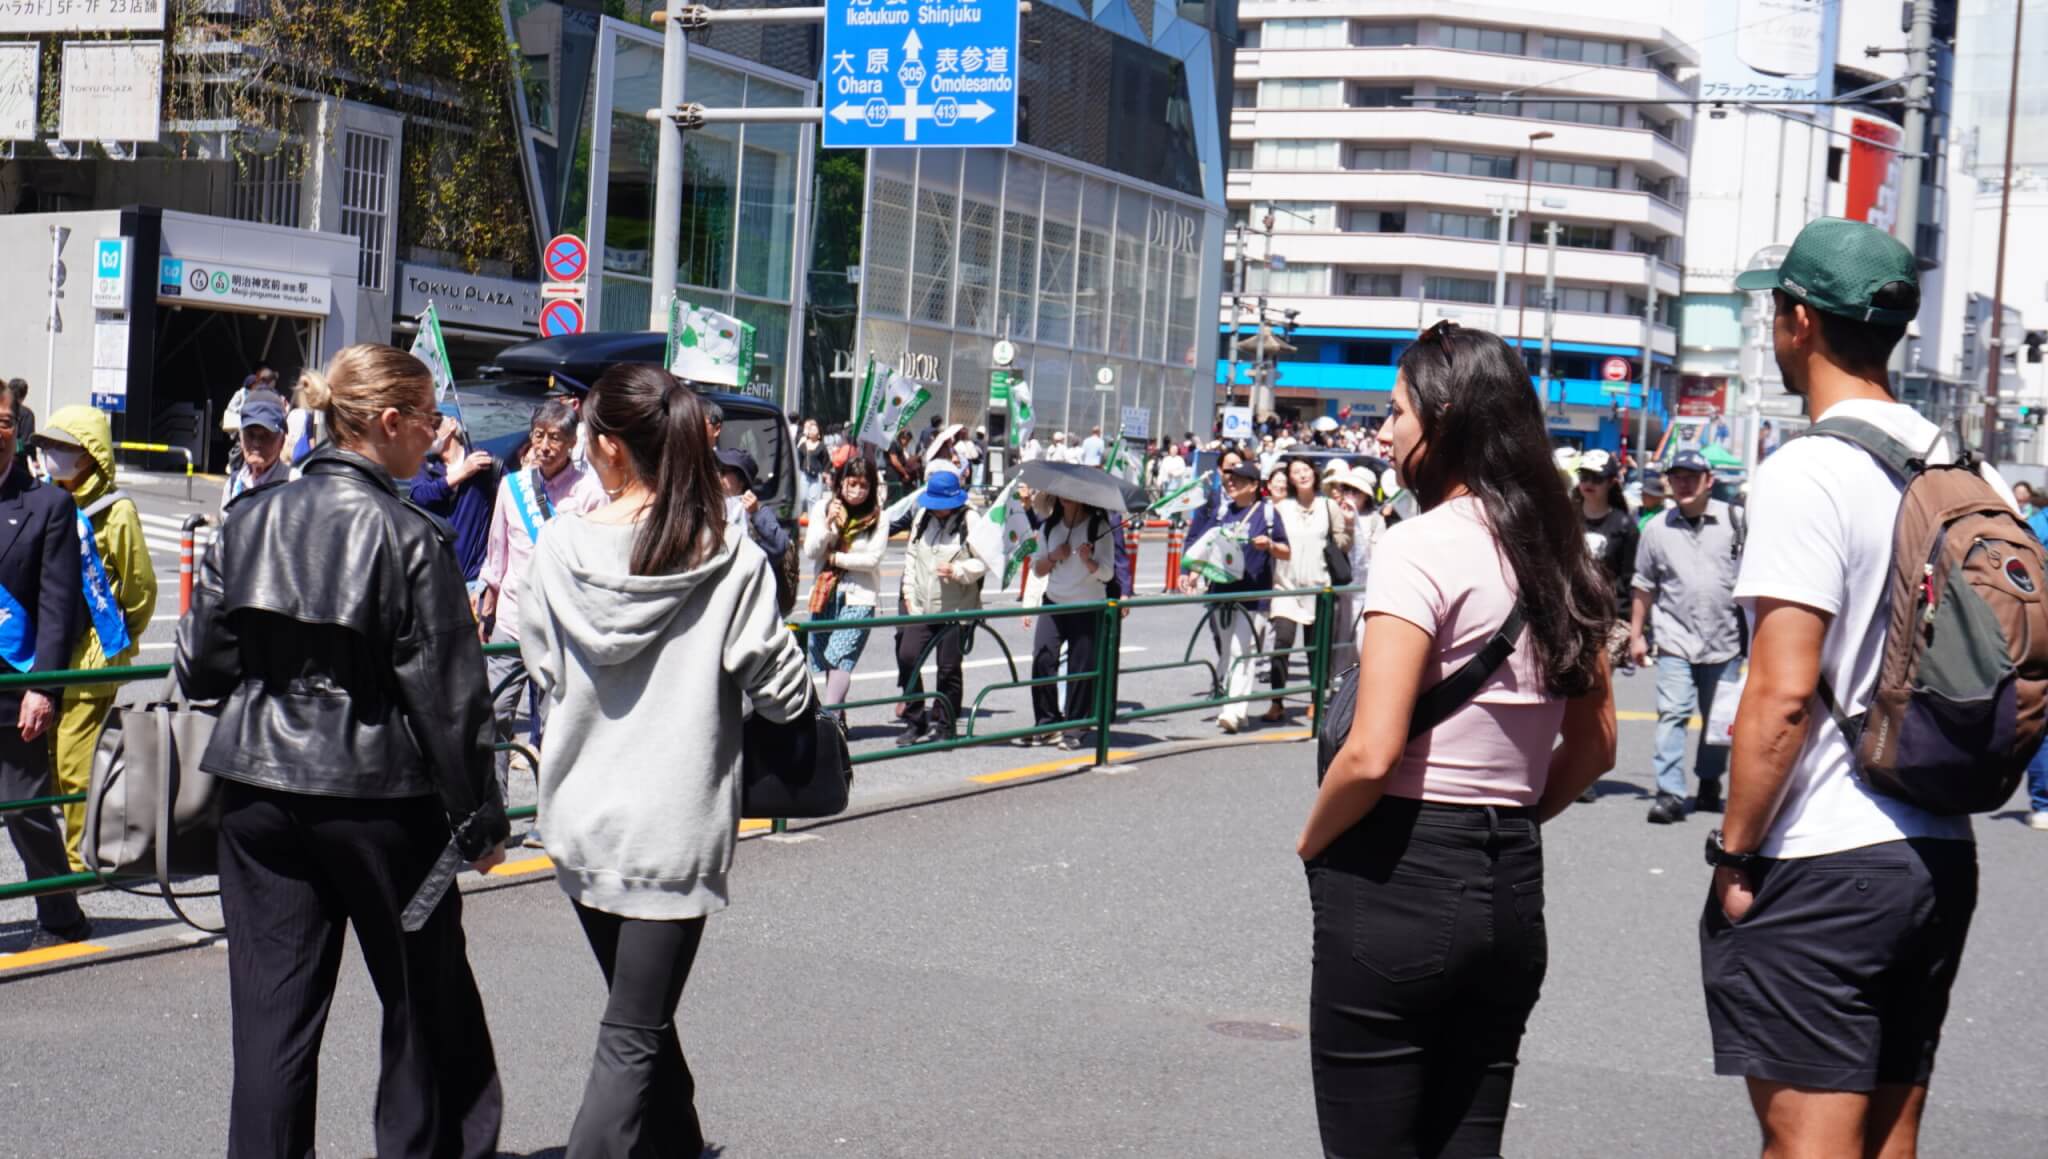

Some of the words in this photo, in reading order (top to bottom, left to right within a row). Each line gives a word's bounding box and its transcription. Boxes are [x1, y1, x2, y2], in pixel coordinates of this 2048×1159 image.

[847, 6, 909, 26] Ikebukuro
[918, 5, 982, 27] Shinjuku
[935, 46, 1009, 74] 表参道
[900, 67, 923, 82] 305
[931, 74, 1013, 93] Omotesando
[838, 76, 883, 95] Ohara
[868, 105, 886, 120] 413
[936, 104, 955, 119] 413
[409, 277, 460, 298] TOKYU
[464, 286, 513, 306] PLAZA
